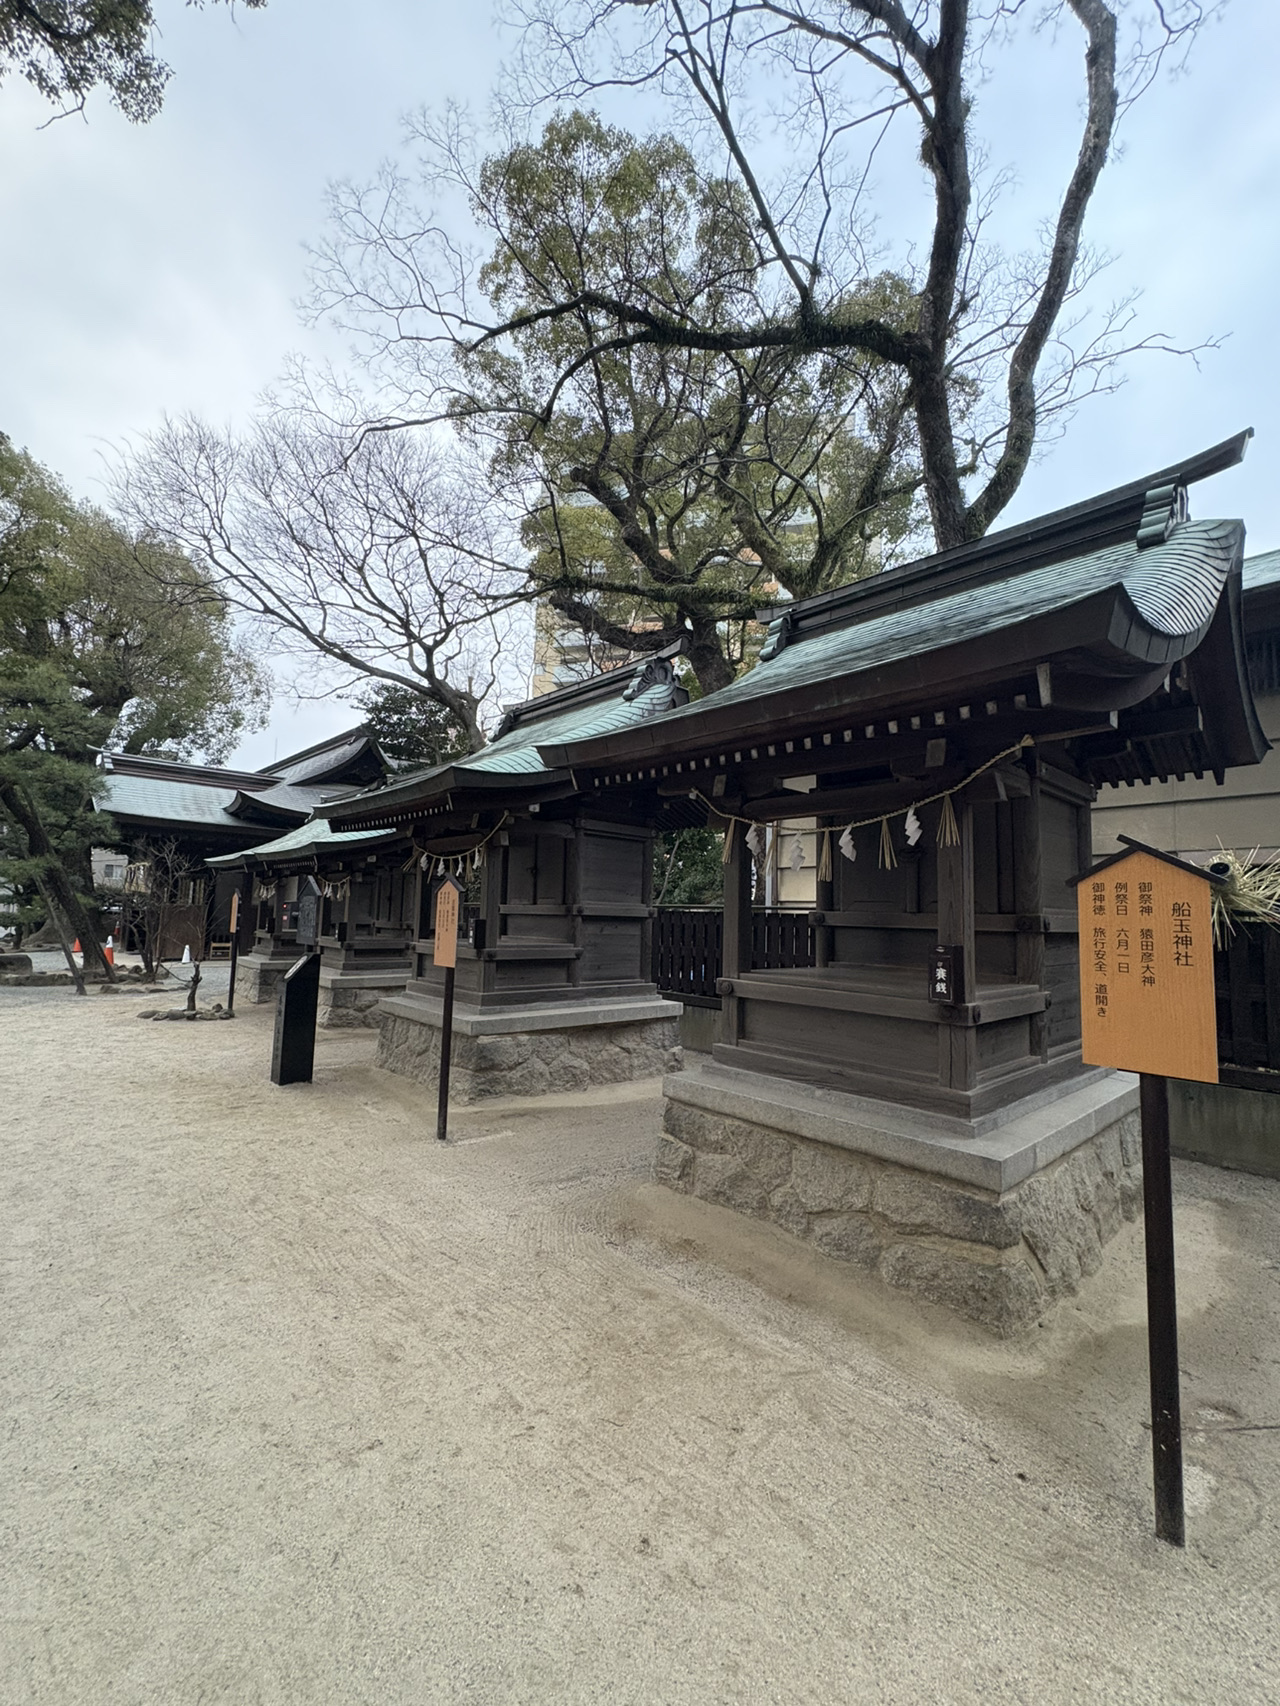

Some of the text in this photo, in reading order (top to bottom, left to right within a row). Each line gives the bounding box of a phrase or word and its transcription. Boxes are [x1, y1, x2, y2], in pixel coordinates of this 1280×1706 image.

[1092, 882, 1105, 916] 御神徳
[1115, 882, 1130, 974] 例祭日 六月一日
[1138, 882, 1155, 987] 御祭神 猿田彦大神
[1171, 901, 1194, 967] 船玉神社
[1095, 983, 1108, 1017] 道開き
